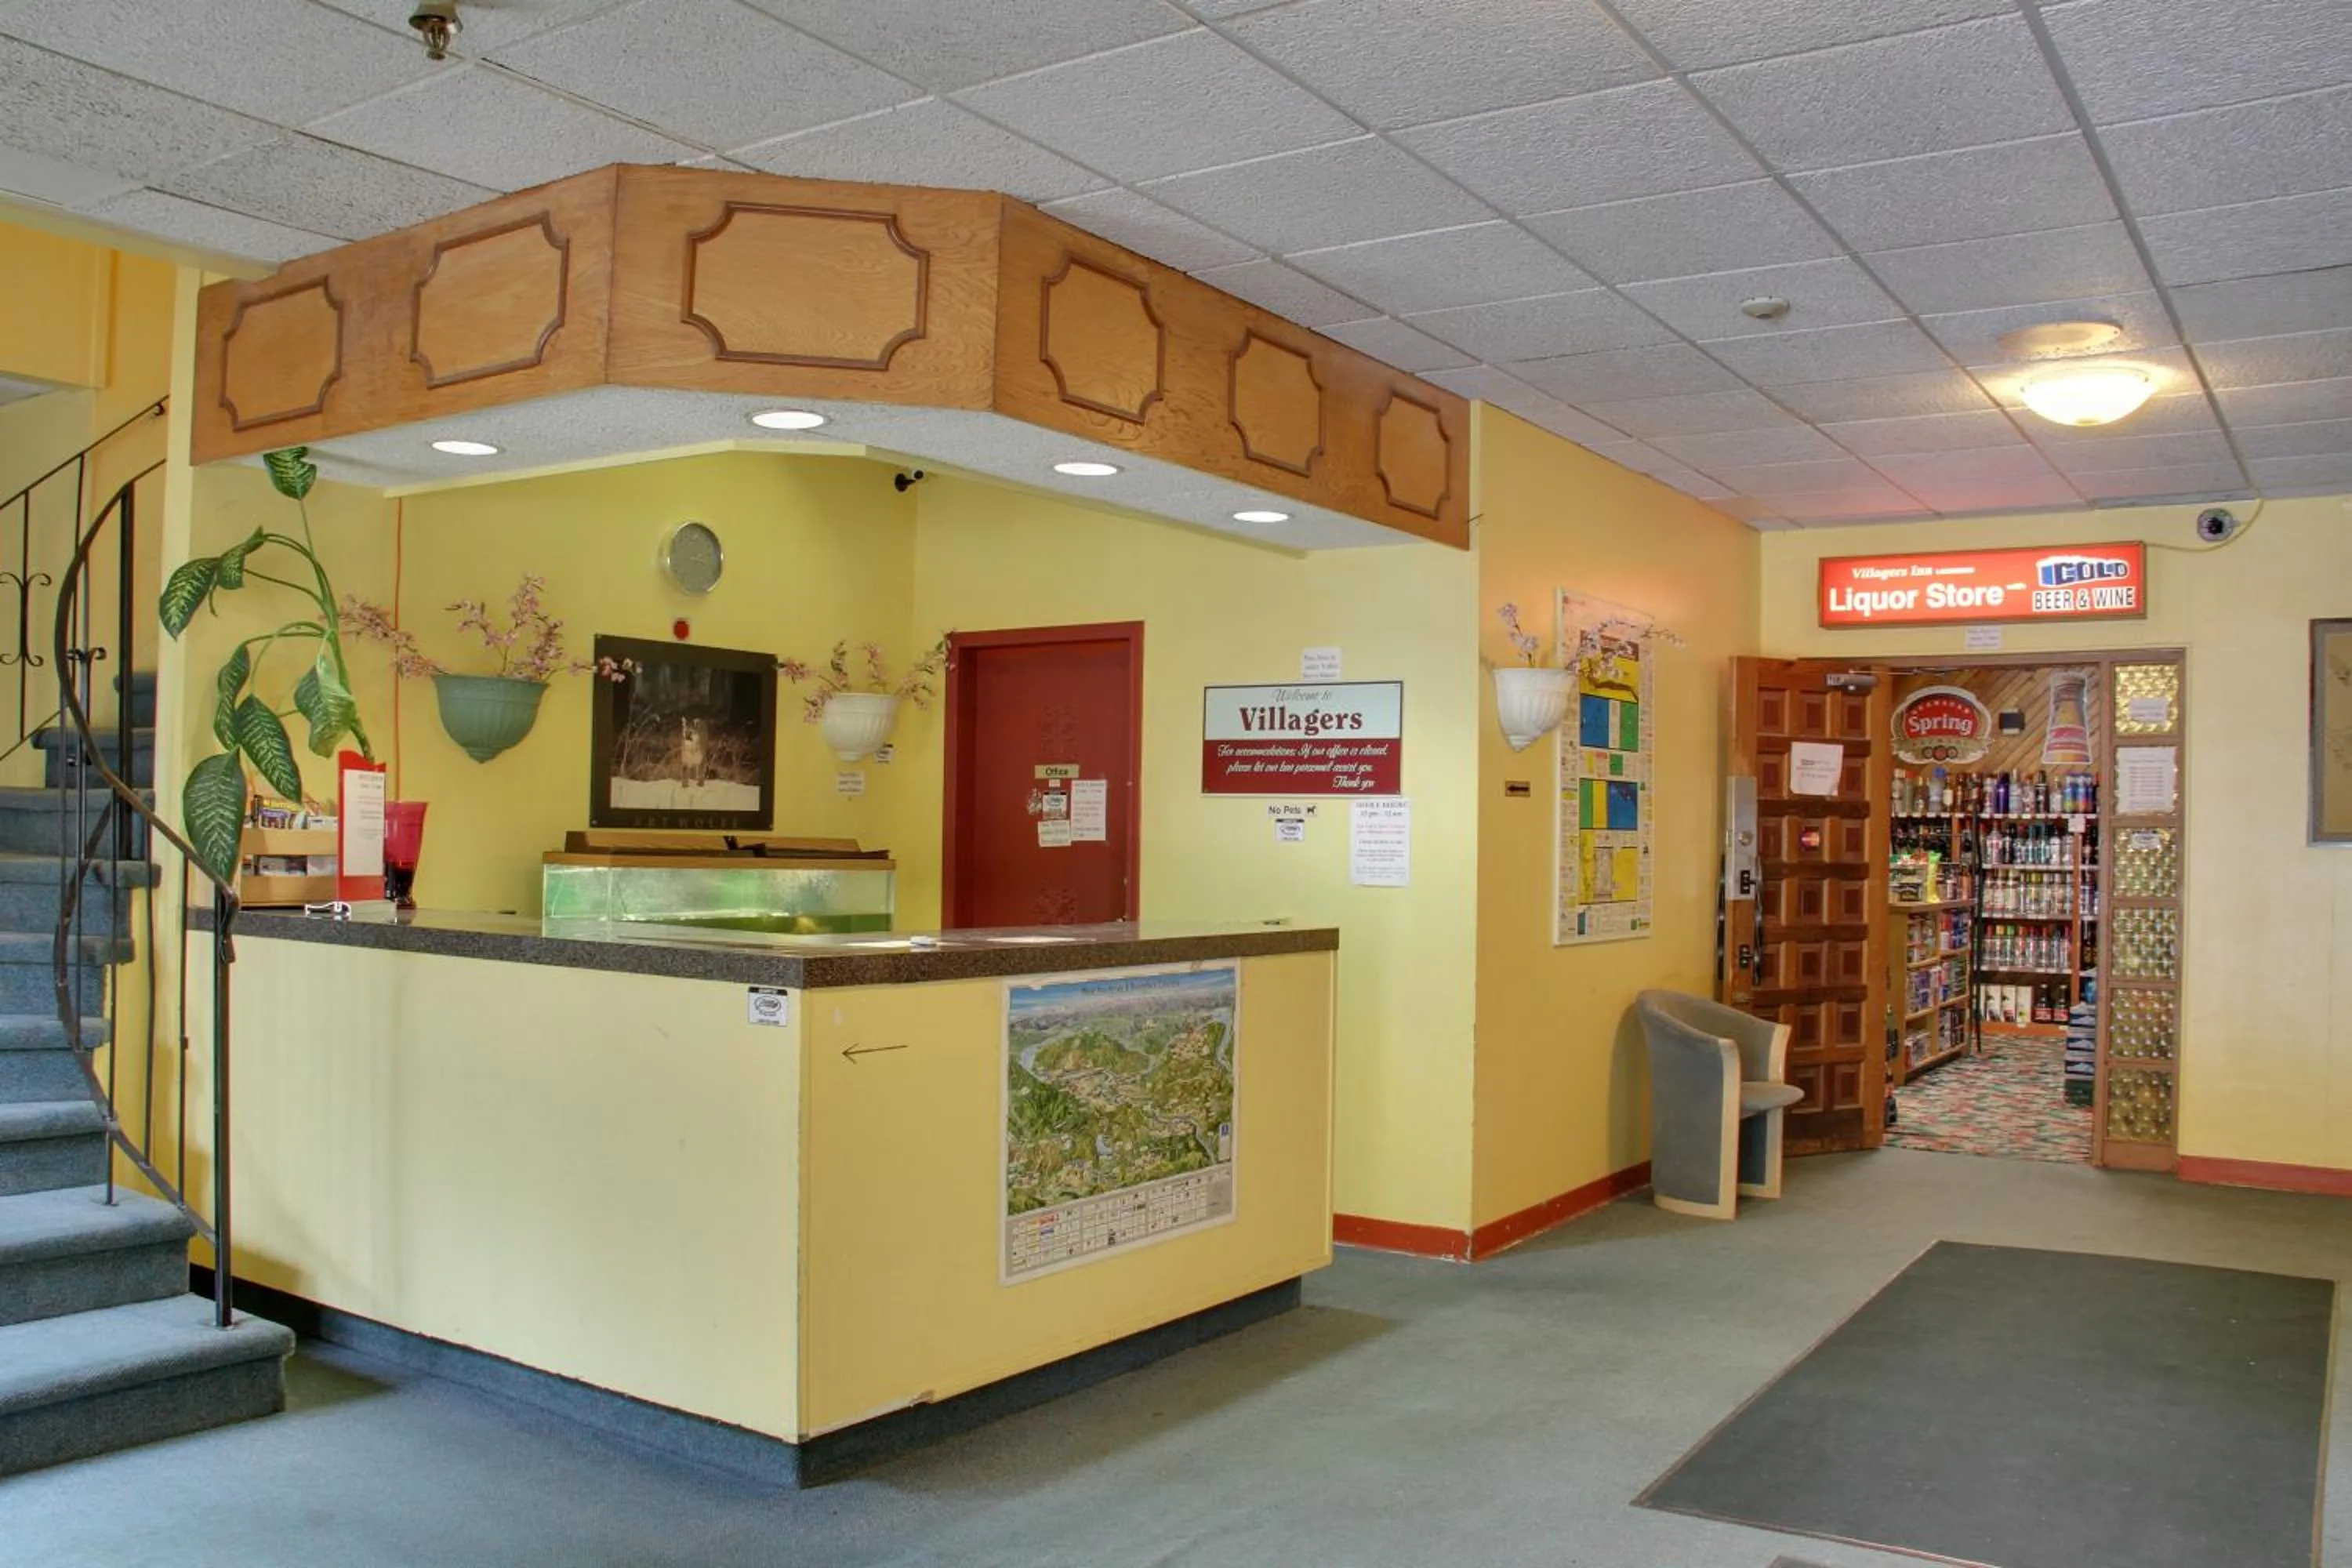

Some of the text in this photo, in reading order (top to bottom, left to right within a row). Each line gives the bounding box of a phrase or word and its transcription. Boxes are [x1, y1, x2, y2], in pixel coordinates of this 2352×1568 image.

[1852, 564, 1933, 580] Villagers Inn
[2042, 561, 2129, 586] COLD
[1829, 583, 2005, 617] Liquor Store
[2034, 587, 2133, 610] BEER & WINE
[1239, 706, 1363, 736] Villagers
[1908, 714, 1973, 736] Spring
[1332, 775, 1361, 789] Thank
[1268, 804, 1301, 815] No Pets
